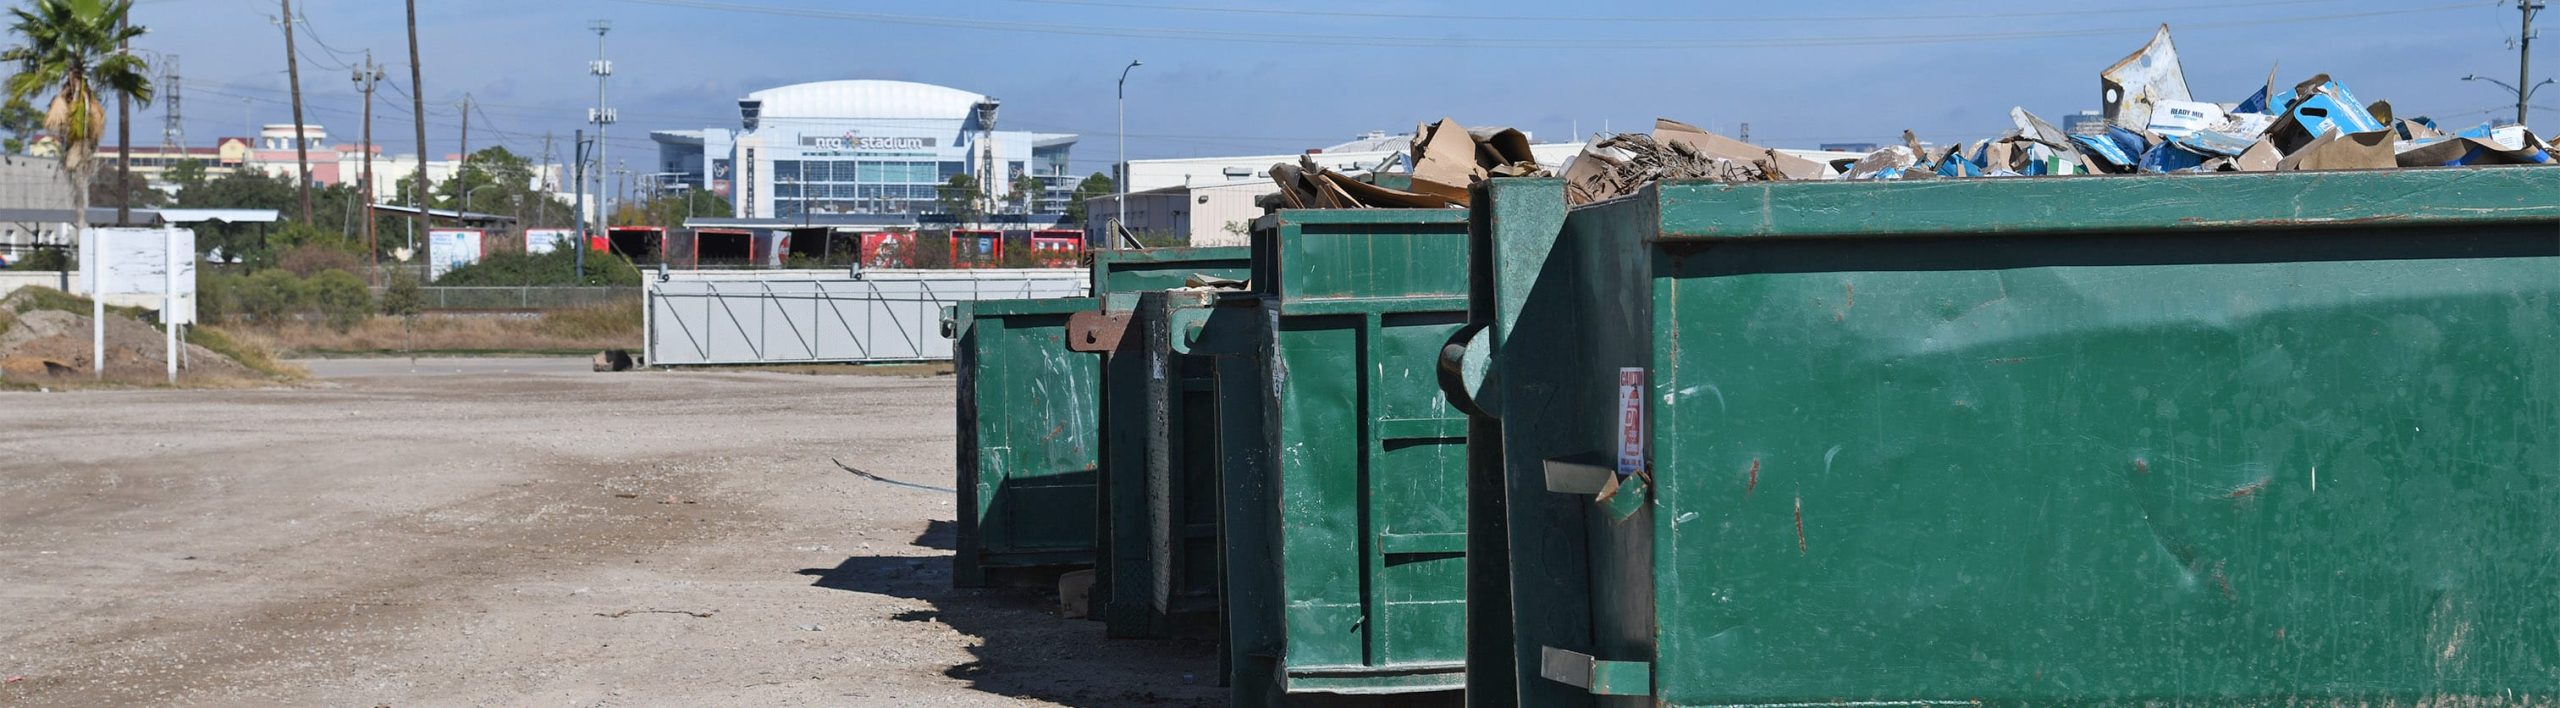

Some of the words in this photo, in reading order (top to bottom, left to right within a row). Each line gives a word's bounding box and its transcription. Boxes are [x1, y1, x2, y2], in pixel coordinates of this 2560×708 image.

[2192, 111, 2204, 119] MIX
[815, 137, 840, 151] nrg
[860, 136, 921, 149] stadium
